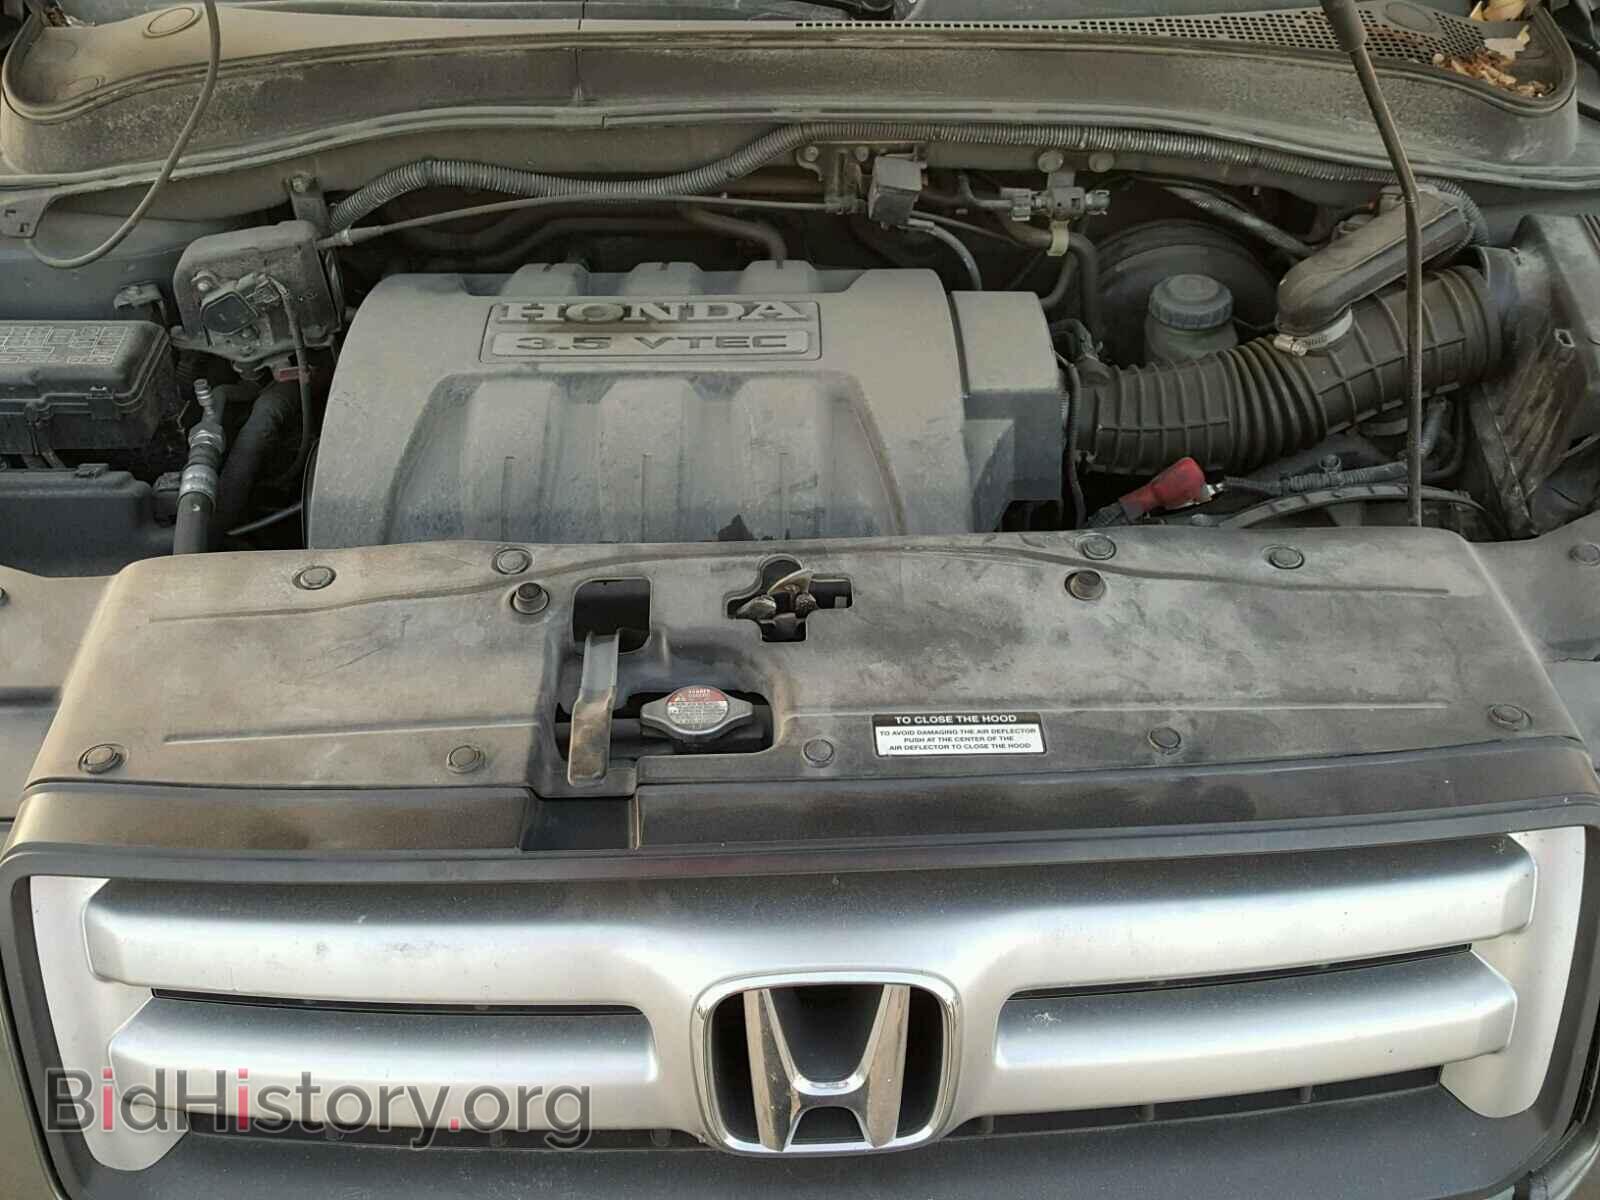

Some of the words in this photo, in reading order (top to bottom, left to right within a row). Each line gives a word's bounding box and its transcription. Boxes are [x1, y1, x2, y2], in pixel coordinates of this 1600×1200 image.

[500, 302, 808, 322] HONDA
[516, 337, 611, 350] 3.5
[634, 336, 787, 349] VTEC
[894, 715, 911, 725] TO
[914, 715, 953, 724] CLOSE
[955, 714, 979, 724] THE
[982, 714, 1017, 723] HOOD
